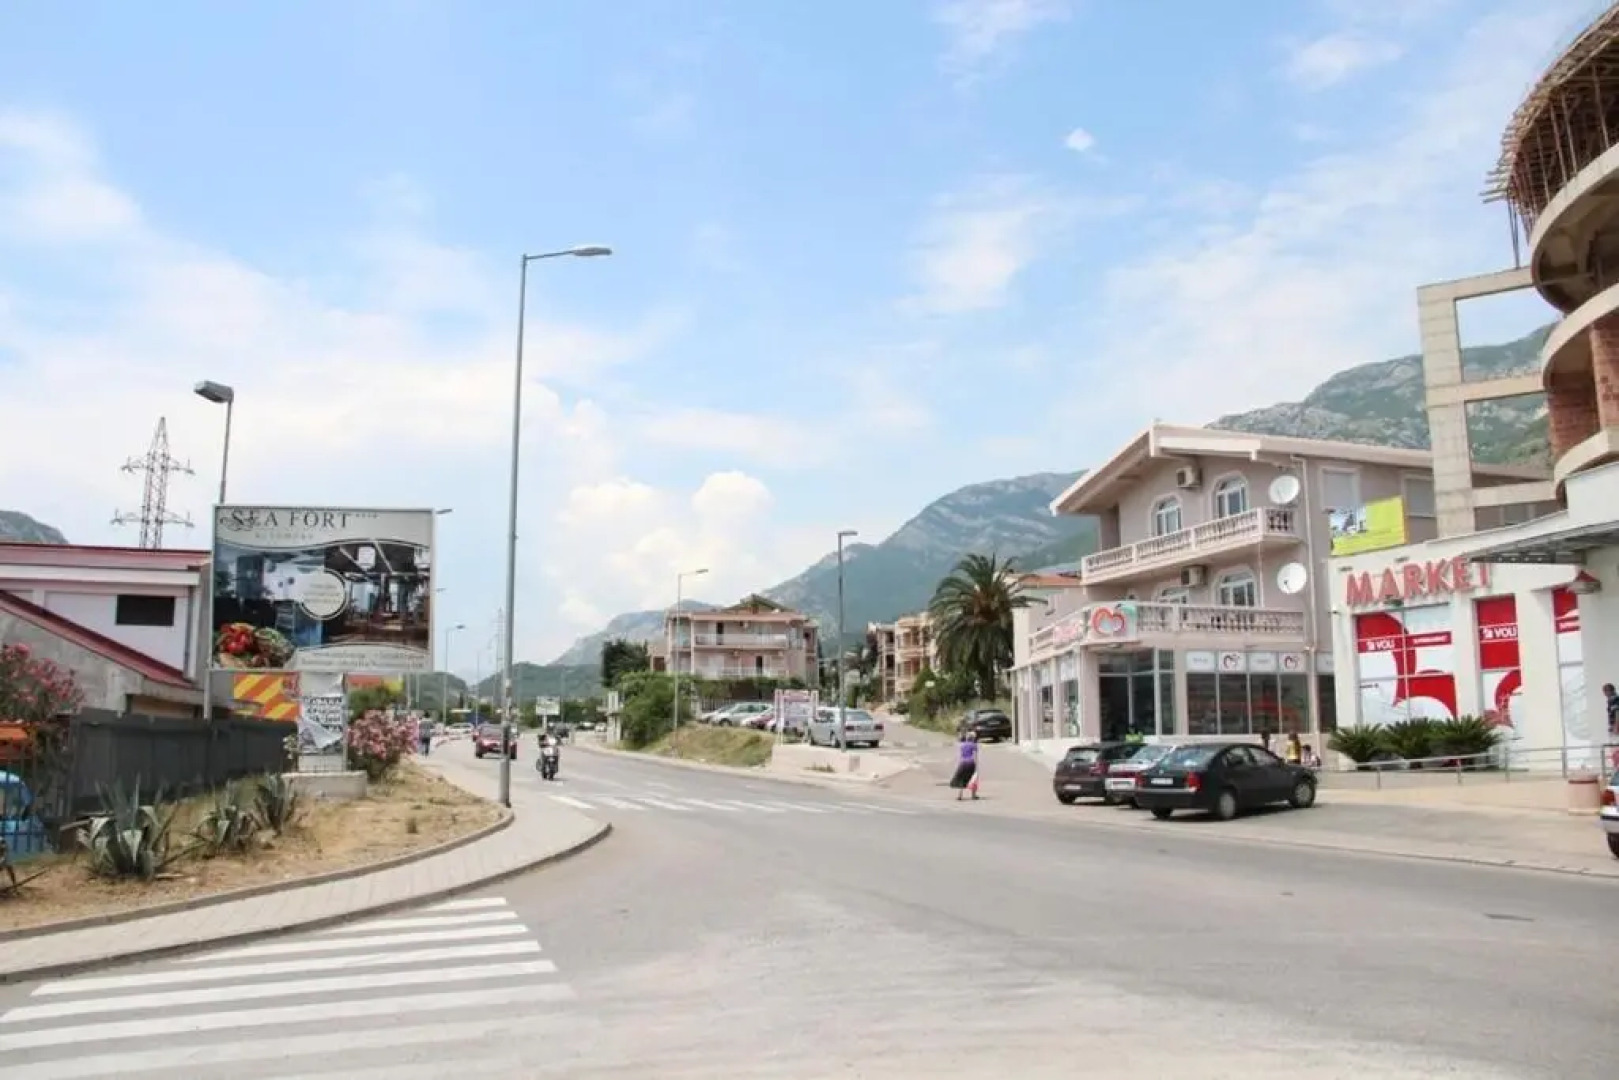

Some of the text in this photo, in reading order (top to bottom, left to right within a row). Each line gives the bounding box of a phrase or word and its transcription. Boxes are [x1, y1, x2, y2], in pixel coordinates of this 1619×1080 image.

[229, 508, 350, 529] SEA FORT
[1346, 552, 1493, 607] MARKET
